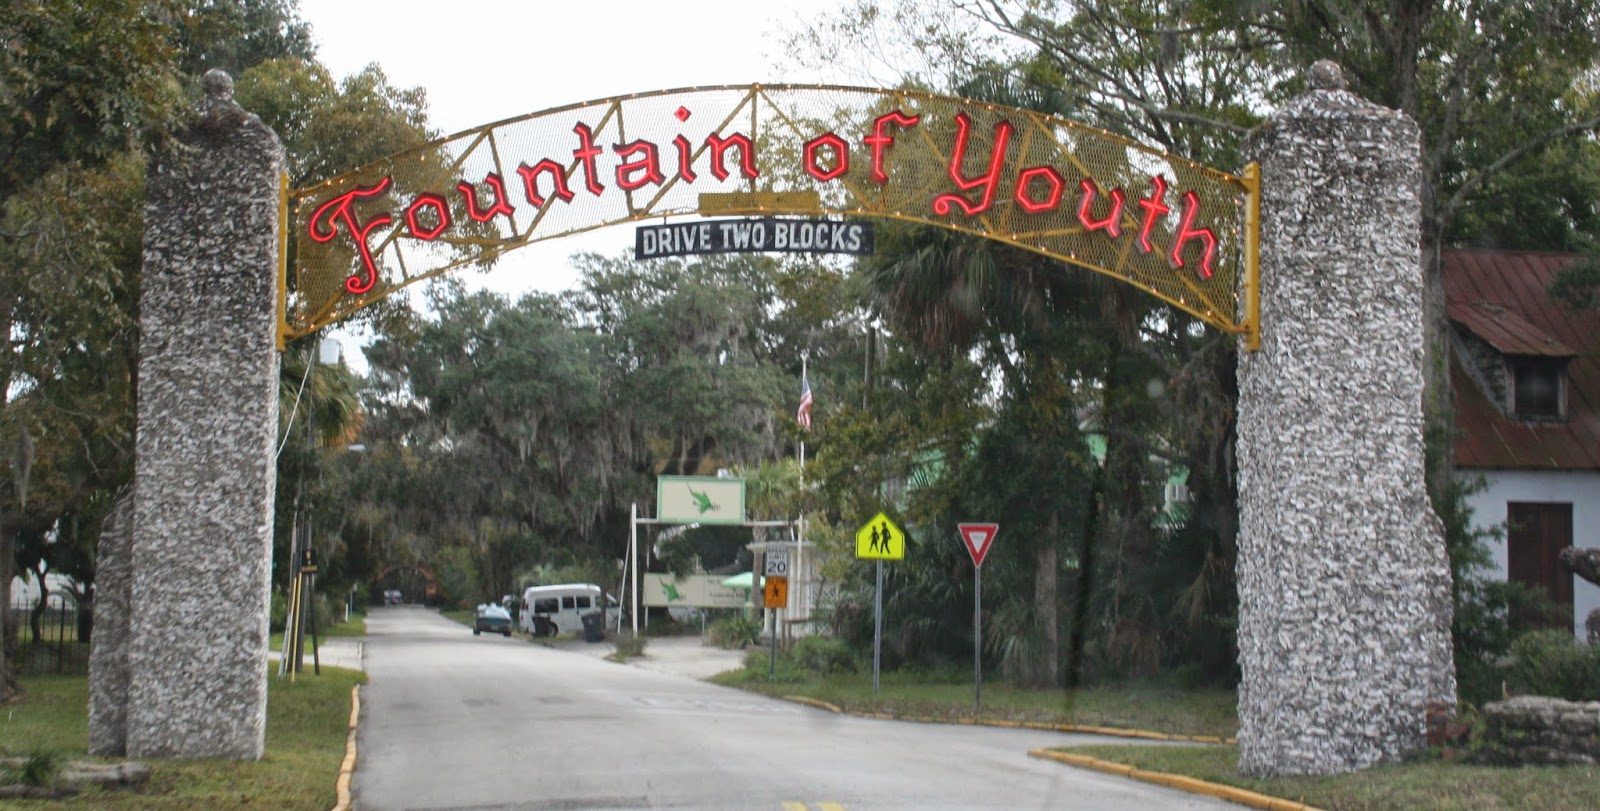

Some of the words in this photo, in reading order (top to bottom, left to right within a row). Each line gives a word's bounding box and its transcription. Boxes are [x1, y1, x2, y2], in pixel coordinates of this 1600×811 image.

[309, 107, 757, 293] Fountain
[803, 111, 919, 186] of
[932, 110, 1219, 279] Youth
[643, 225, 712, 255] DRIVE
[719, 222, 766, 250] TWO
[774, 221, 863, 251] BLOCKS
[768, 561, 786, 573] 20
